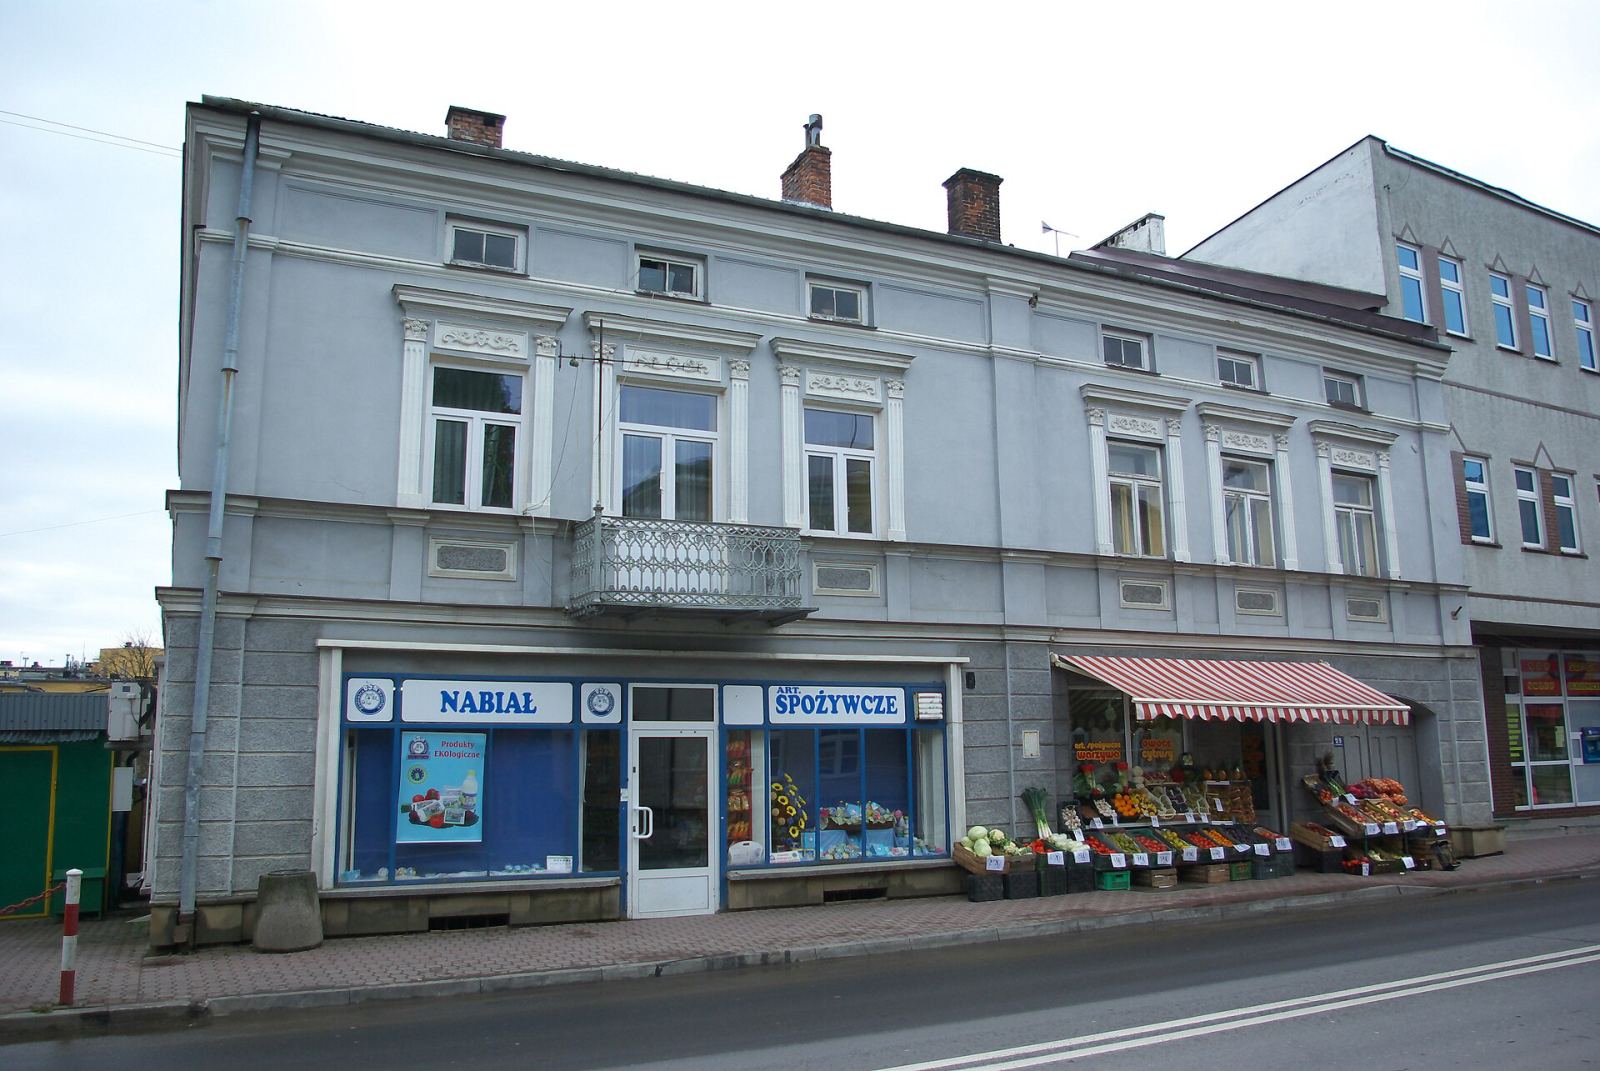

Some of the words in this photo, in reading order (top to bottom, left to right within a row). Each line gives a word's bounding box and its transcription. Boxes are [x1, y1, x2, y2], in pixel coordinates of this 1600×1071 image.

[776, 686, 801, 694] ART.
[440, 690, 537, 714] NABIAŁ
[776, 690, 898, 714] SPOŻYWCZE
[441, 741, 475, 749] Produkty
[434, 750, 481, 759] EKOlogiczne
[1076, 750, 1121, 764] warzywa
